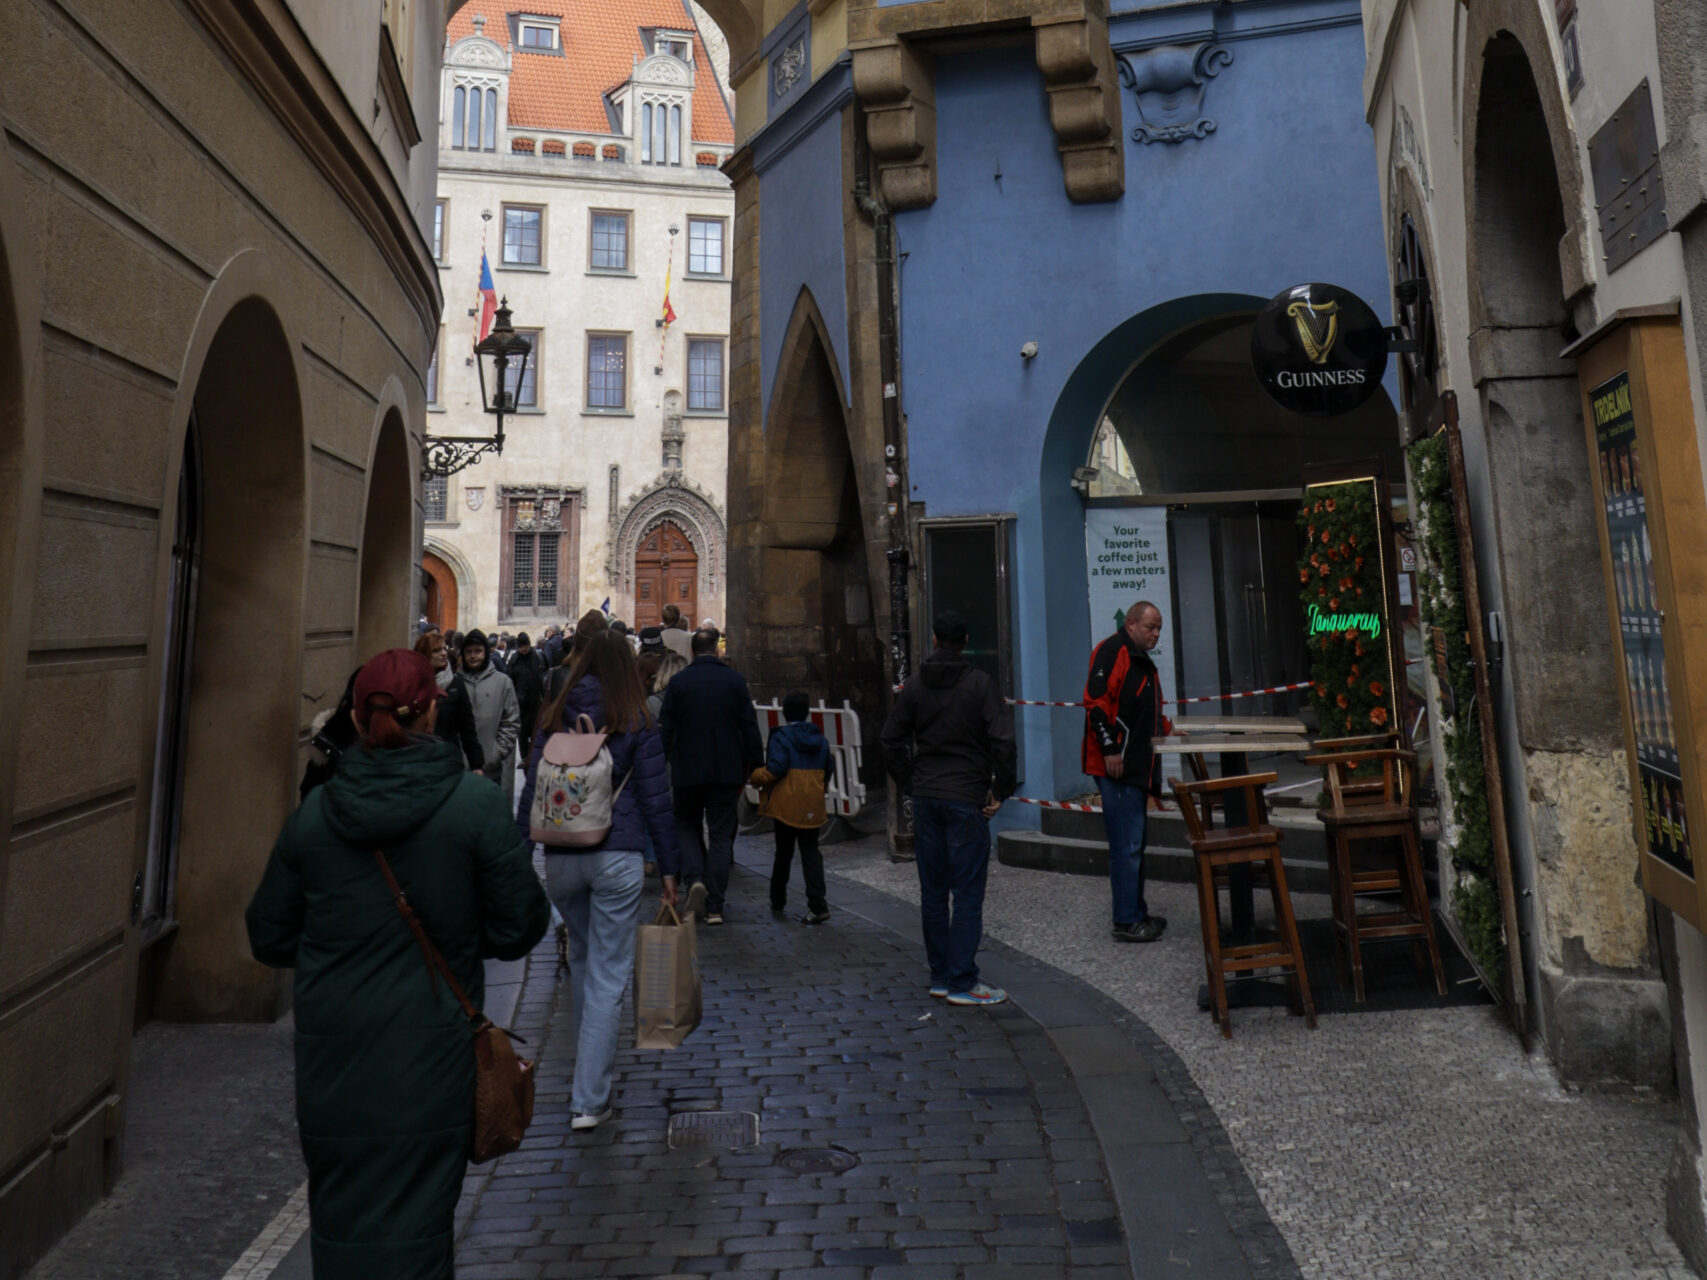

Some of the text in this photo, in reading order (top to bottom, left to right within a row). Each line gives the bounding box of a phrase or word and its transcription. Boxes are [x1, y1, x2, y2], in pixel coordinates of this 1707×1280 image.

[1277, 369, 1365, 388] GUINNESS
[1113, 526, 1139, 536] Your
[1104, 538, 1150, 549] favorite
[1097, 551, 1158, 565] coffee just
[1092, 565, 1166, 576] a few meters
[1112, 578, 1146, 591] away!
